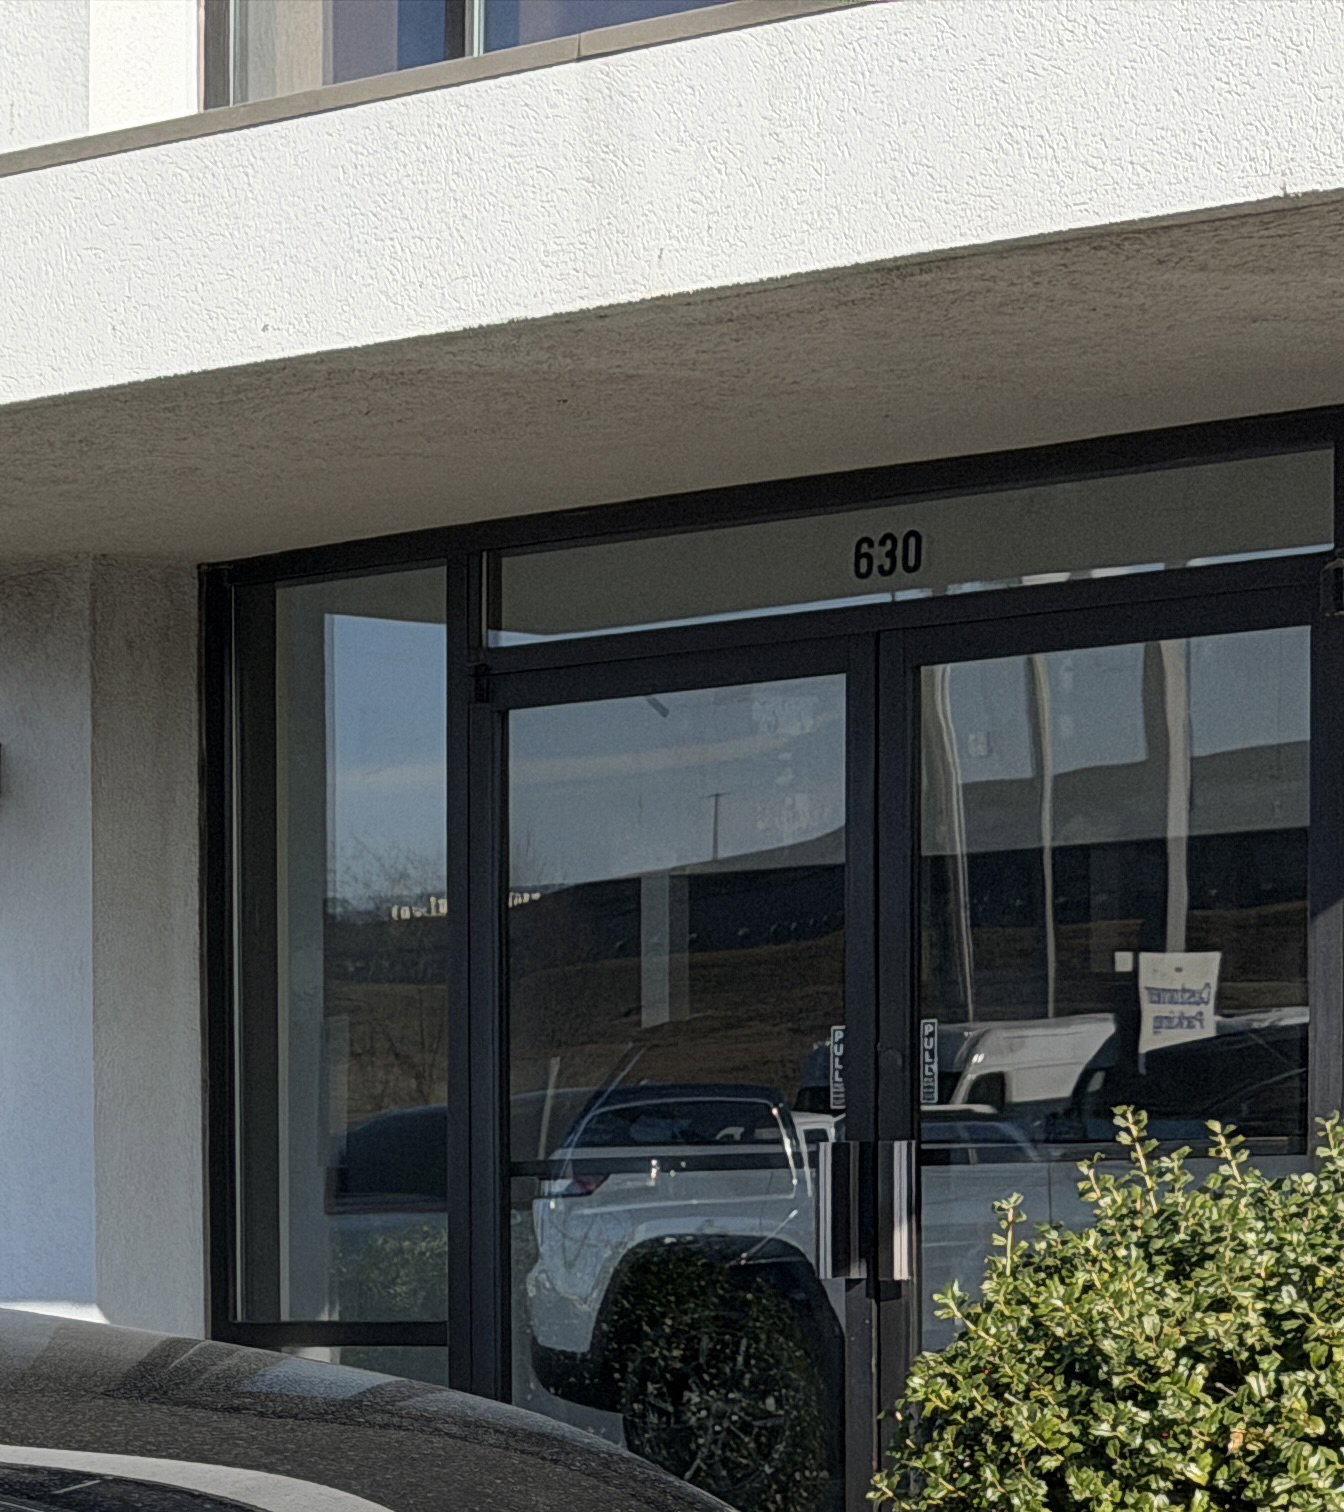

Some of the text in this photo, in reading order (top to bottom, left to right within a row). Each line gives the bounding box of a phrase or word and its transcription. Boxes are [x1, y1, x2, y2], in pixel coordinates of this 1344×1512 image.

[853, 529, 923, 580] 630
[833, 1030, 844, 1082] PULL
[923, 1024, 935, 1076] PULL
